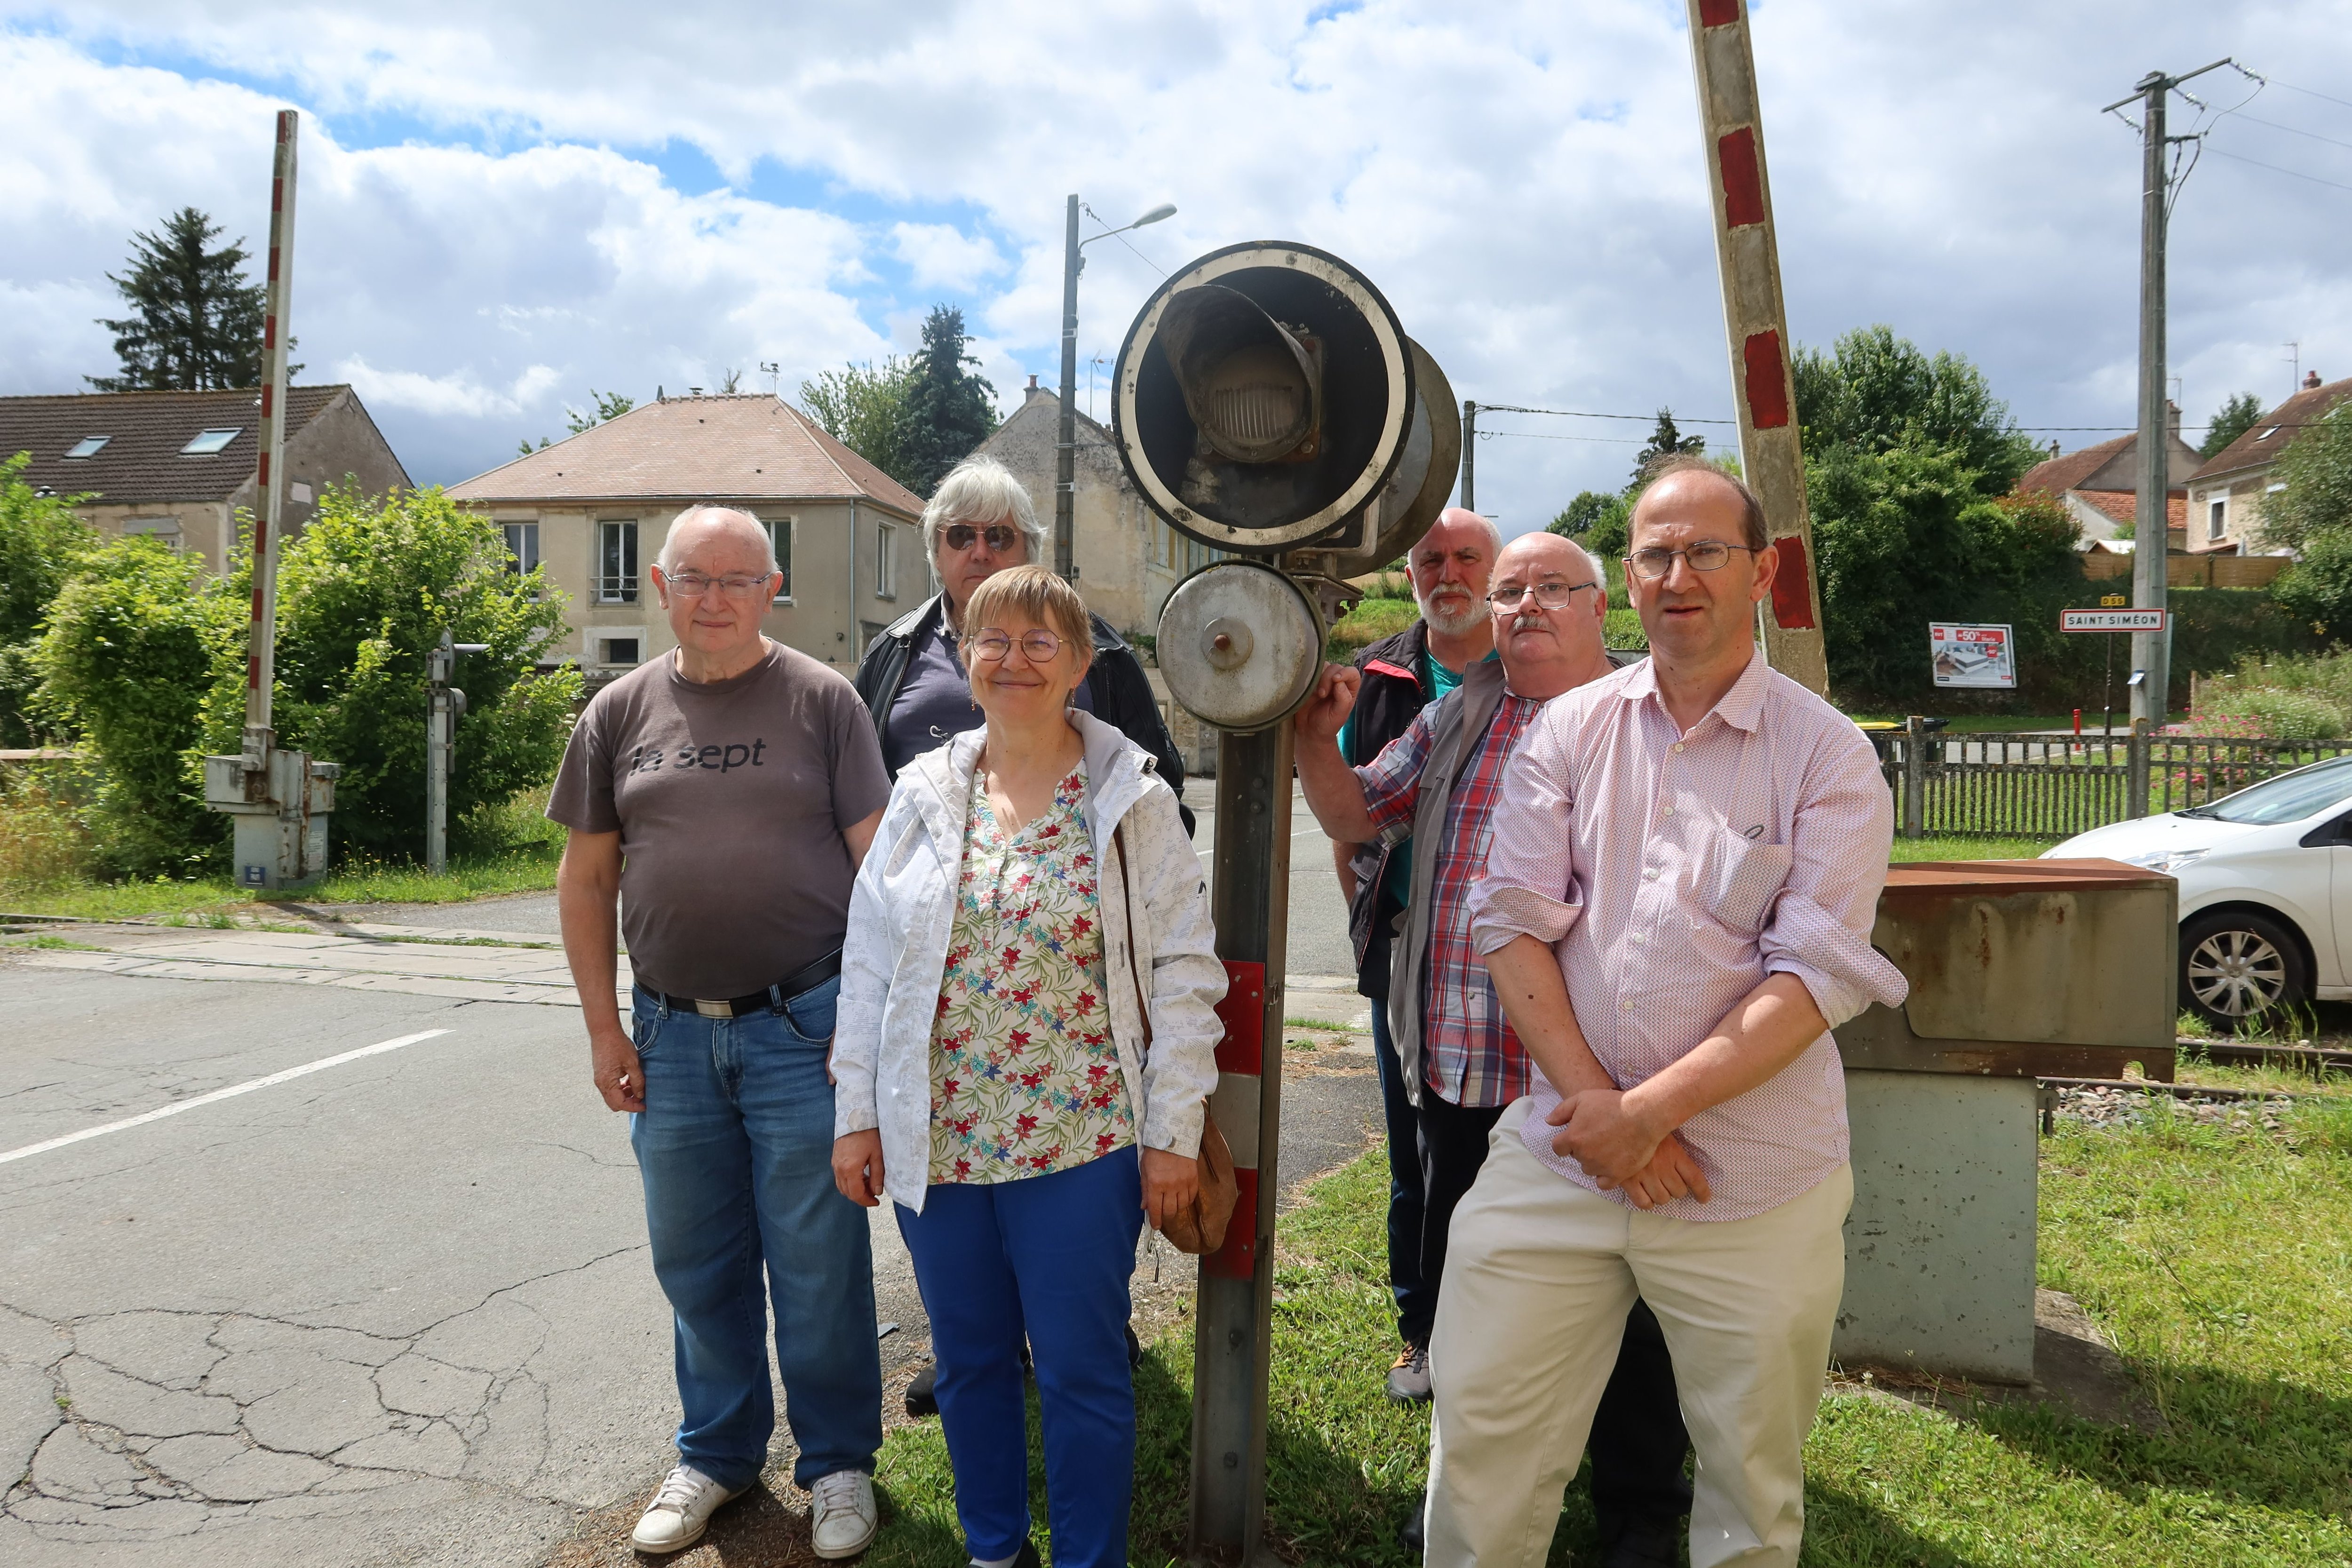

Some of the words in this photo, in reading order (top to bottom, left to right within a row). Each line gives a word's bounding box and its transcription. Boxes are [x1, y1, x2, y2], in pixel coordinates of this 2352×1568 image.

[2068, 616, 2104, 624] SAINT
[2109, 614, 2157, 624] SIMÉON
[673, 738, 766, 773] sept
